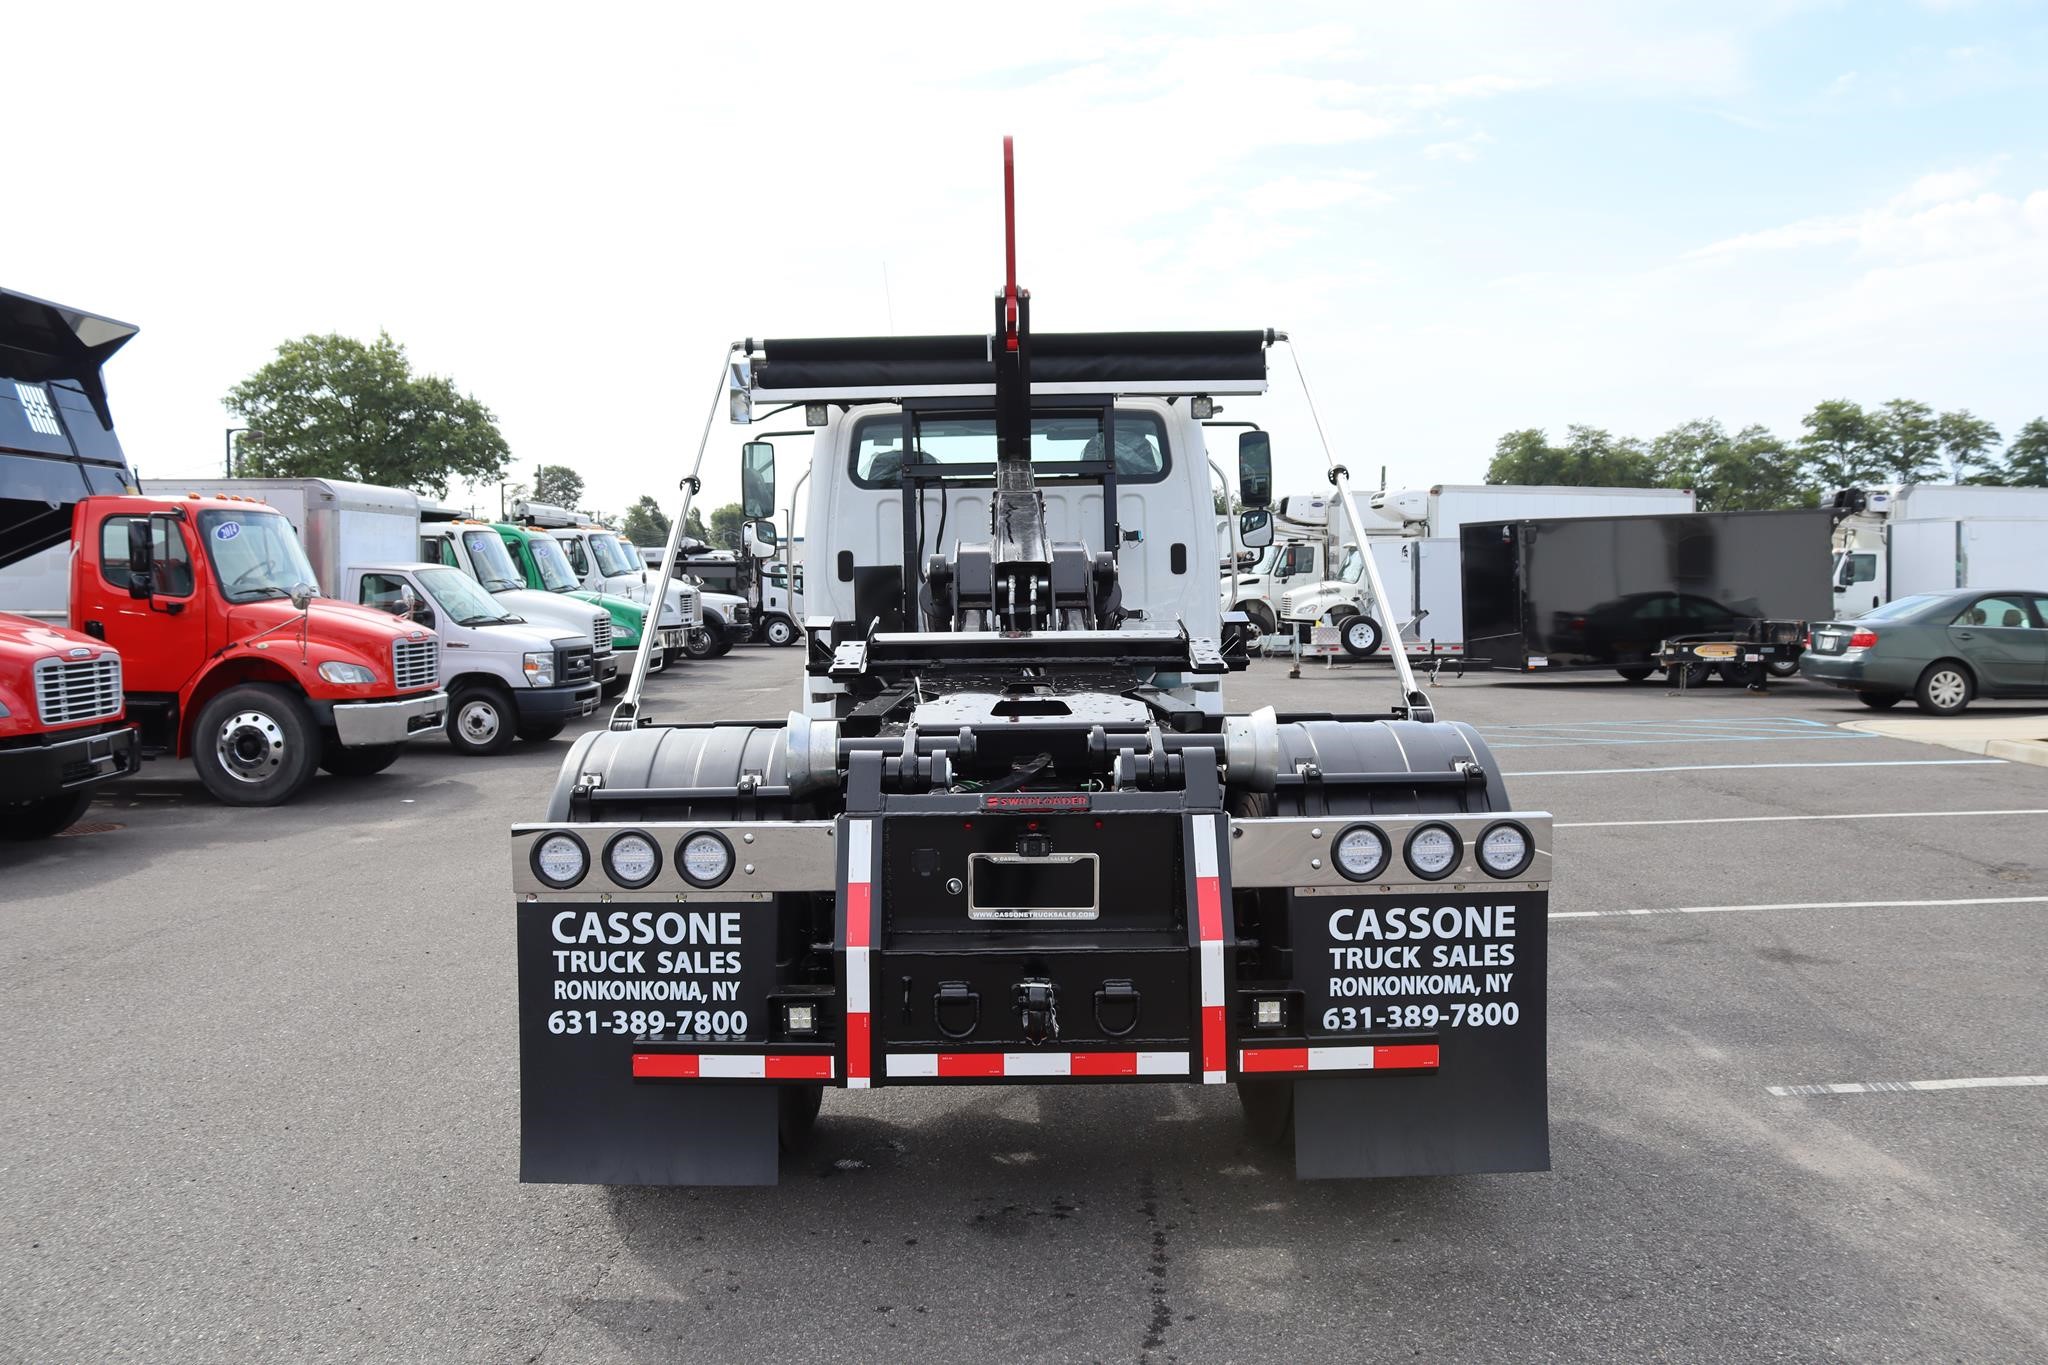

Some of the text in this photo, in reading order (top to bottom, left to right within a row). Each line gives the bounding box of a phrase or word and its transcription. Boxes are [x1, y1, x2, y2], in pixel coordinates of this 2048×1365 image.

[1001, 796, 1086, 806] SWAPLOADER
[551, 911, 742, 945] CASSONE
[1328, 905, 1516, 941] CASSONE
[553, 950, 742, 974] TRUCK SALES
[1329, 943, 1515, 970] TRUCK SALES
[554, 980, 741, 1004] RONKONKOMA, NY
[1329, 973, 1514, 997] RONKONKOMA, NY
[547, 1010, 748, 1035] 631-389-7800
[1322, 1001, 1520, 1030] 631-389-7800
